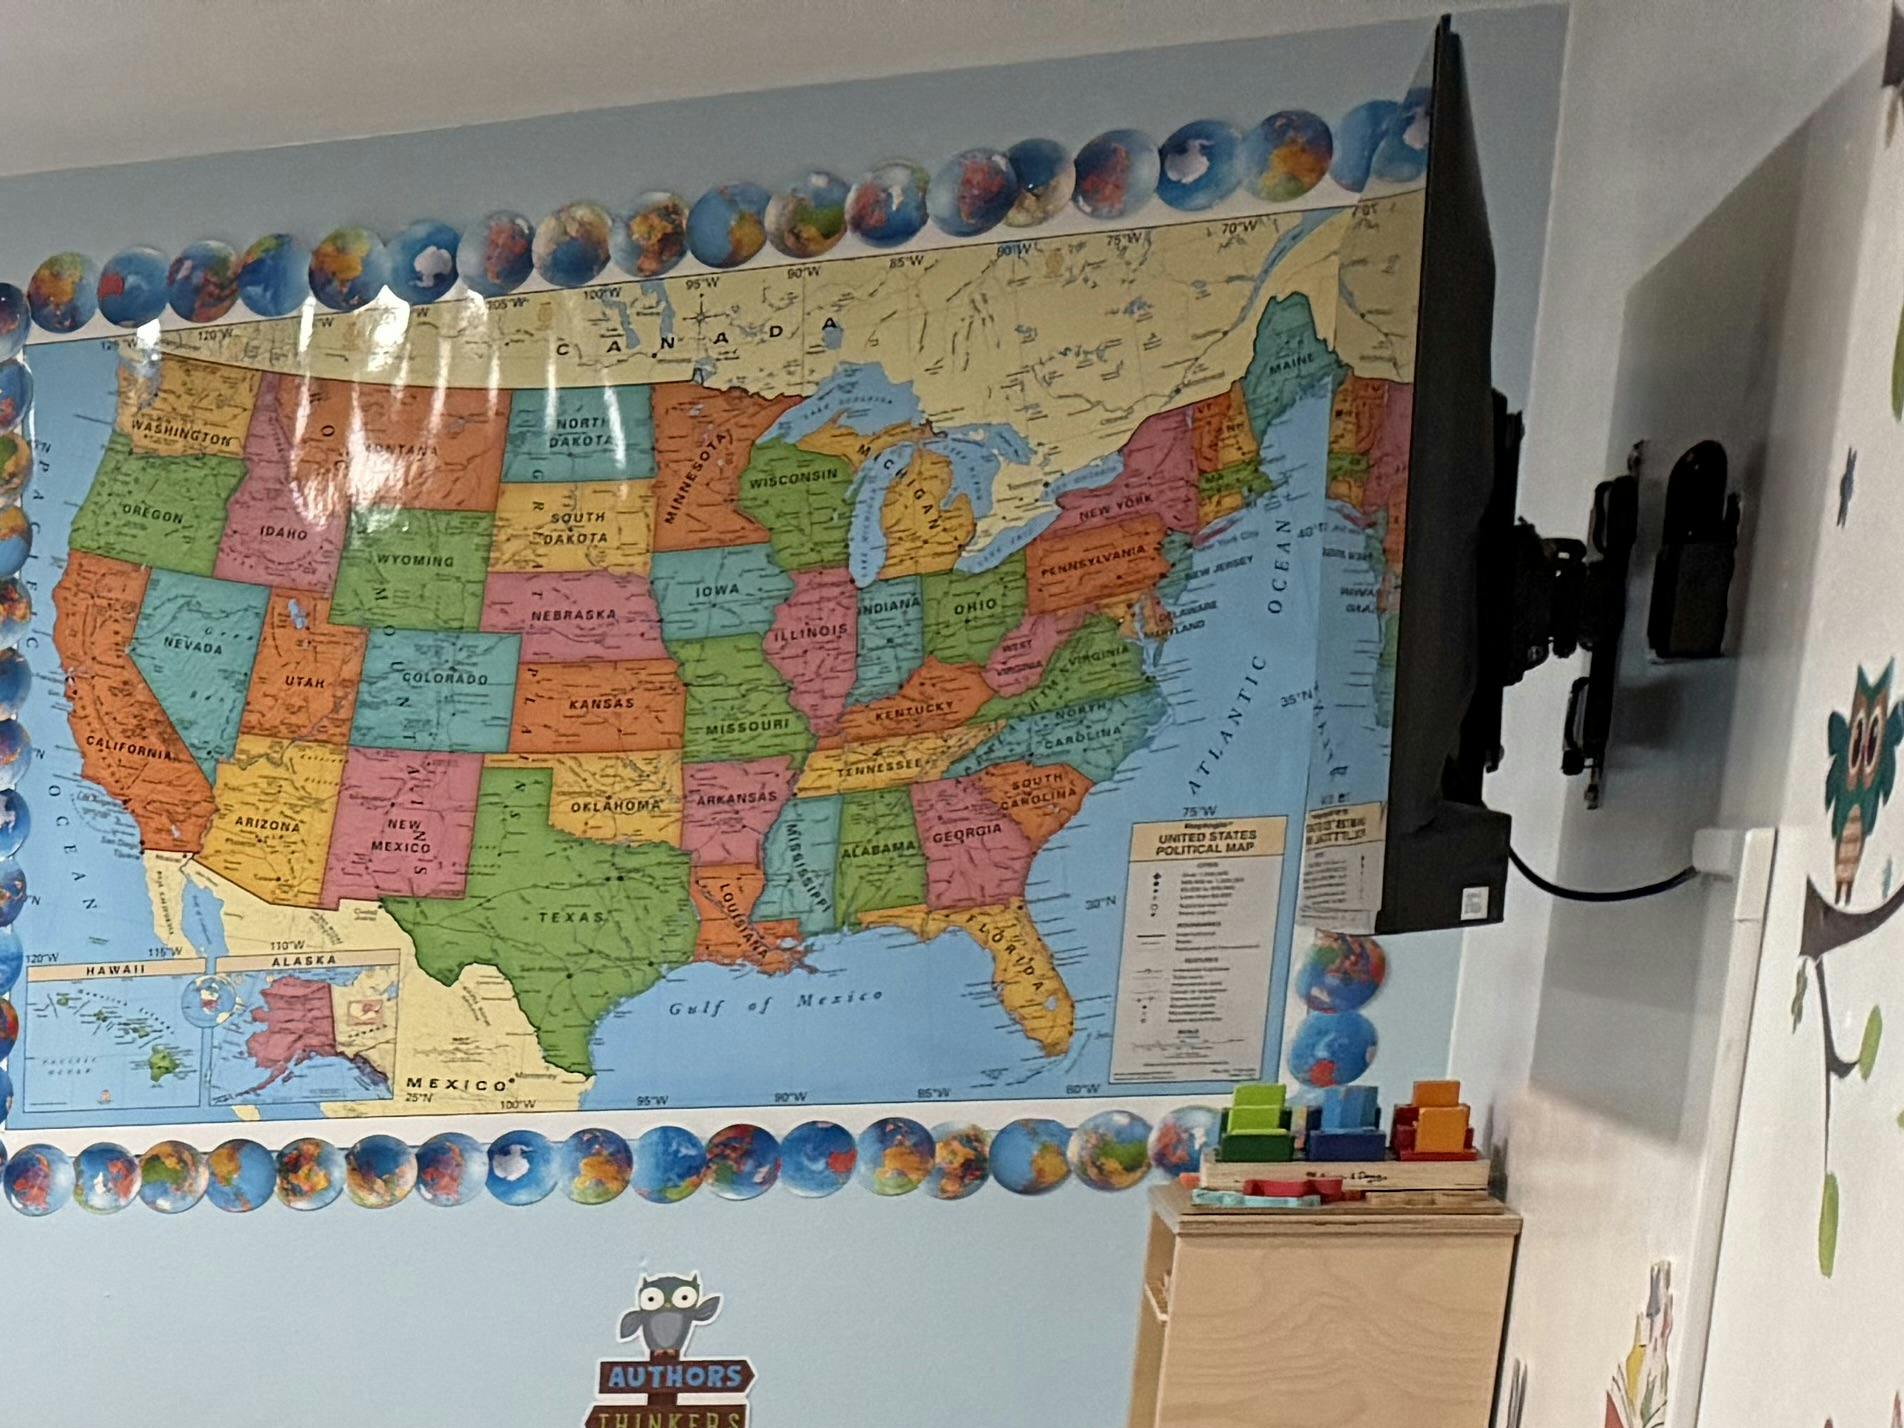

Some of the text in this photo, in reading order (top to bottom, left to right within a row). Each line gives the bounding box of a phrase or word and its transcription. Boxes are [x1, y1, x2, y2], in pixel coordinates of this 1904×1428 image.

[131, 419, 232, 448] WASHINGTON
[664, 433, 728, 524] MINNESOTA
[749, 469, 838, 489] WISCONSIN
[122, 502, 184, 524] OREGON
[259, 526, 309, 542] IDAHO
[377, 552, 454, 569] WYOMING
[1041, 544, 1146, 577] PENNSYLVANIA
[696, 584, 740, 598] IOWA
[531, 609, 616, 621] NEBRASKA
[954, 599, 997, 615] OHIO
[774, 624, 848, 642] ILLINOIS
[164, 636, 223, 656] NEVADA
[285, 675, 326, 690] UTAH
[402, 671, 489, 687] COLORADO
[569, 698, 634, 710] KANSAS
[706, 718, 790, 735] MISSOURI
[86, 735, 173, 762] CALIFORNIA
[571, 800, 661, 813] OKLAHOMA
[697, 791, 778, 806] ARKANSAS
[234, 815, 301, 834] ARIZONA
[387, 818, 421, 831] NEW
[933, 824, 1002, 844] GEORGIA
[1159, 830, 1257, 844] UNITED STATES
[371, 840, 431, 854] MEXICO
[842, 840, 915, 858] ALABAMA
[1156, 842, 1255, 856] POLITICAL MAP
[538, 911, 605, 925] TEXAS
[272, 954, 337, 967] ALASKA
[86, 963, 146, 976] HAWAII
[669, 990, 882, 1017] Gulf of Mexico
[407, 1076, 506, 1091] MEXICO
[608, 1365, 743, 1388] AUTHORS
